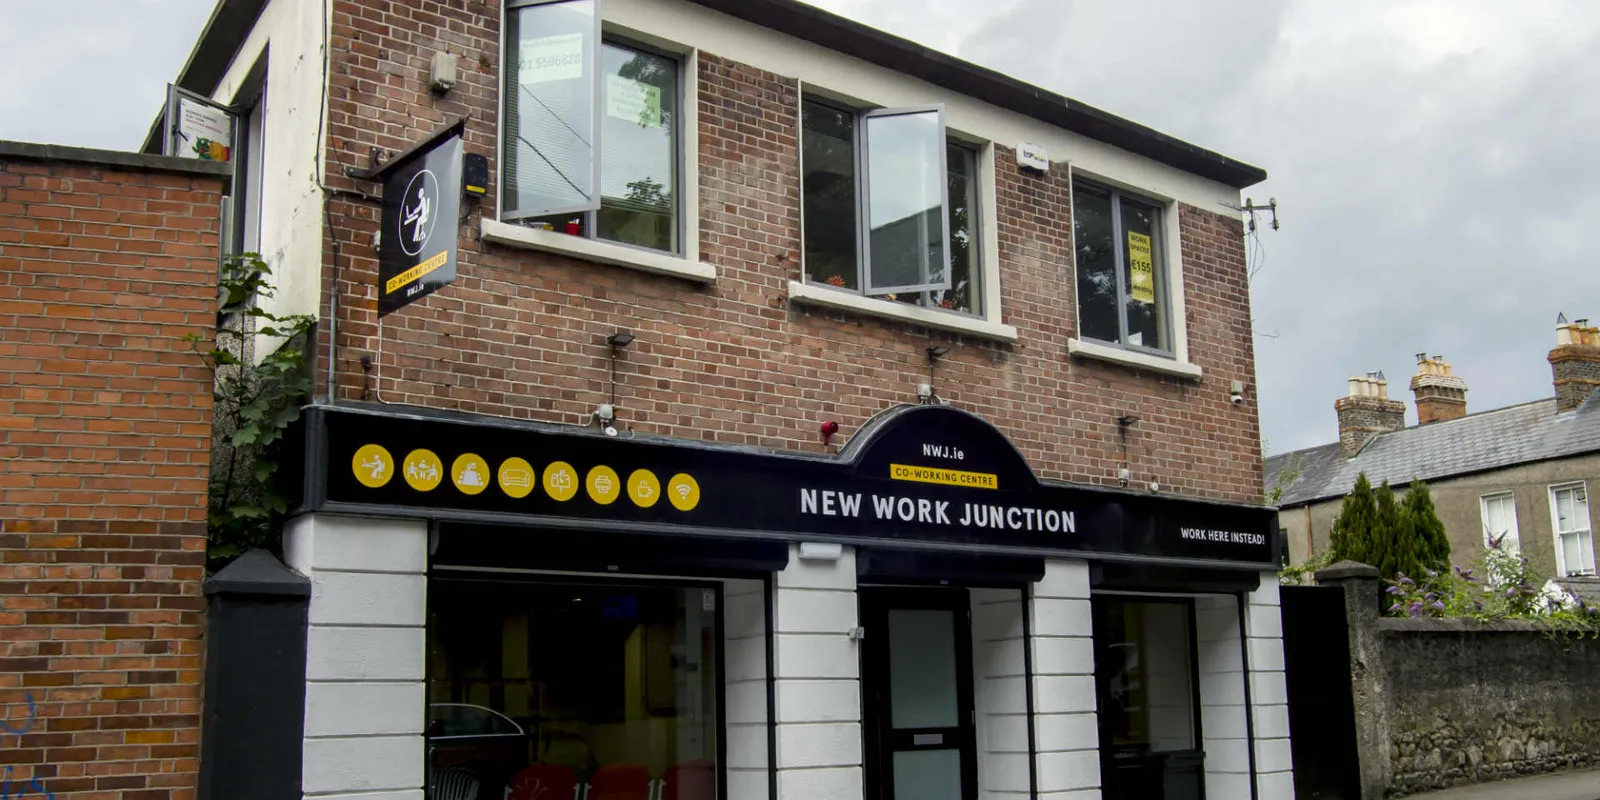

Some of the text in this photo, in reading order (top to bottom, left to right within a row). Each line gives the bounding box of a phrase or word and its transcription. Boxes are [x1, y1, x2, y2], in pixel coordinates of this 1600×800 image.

[389, 254, 445, 290] CO-WORKING CENTRE
[1131, 259, 1151, 273] €155
[922, 443, 964, 460] NWJ.ie
[895, 467, 993, 485] CO-WORKING CENTRE
[801, 488, 1076, 533] NEW WORK JUNCTION
[1180, 527, 1265, 545] WORK HERE INSTEAD!
